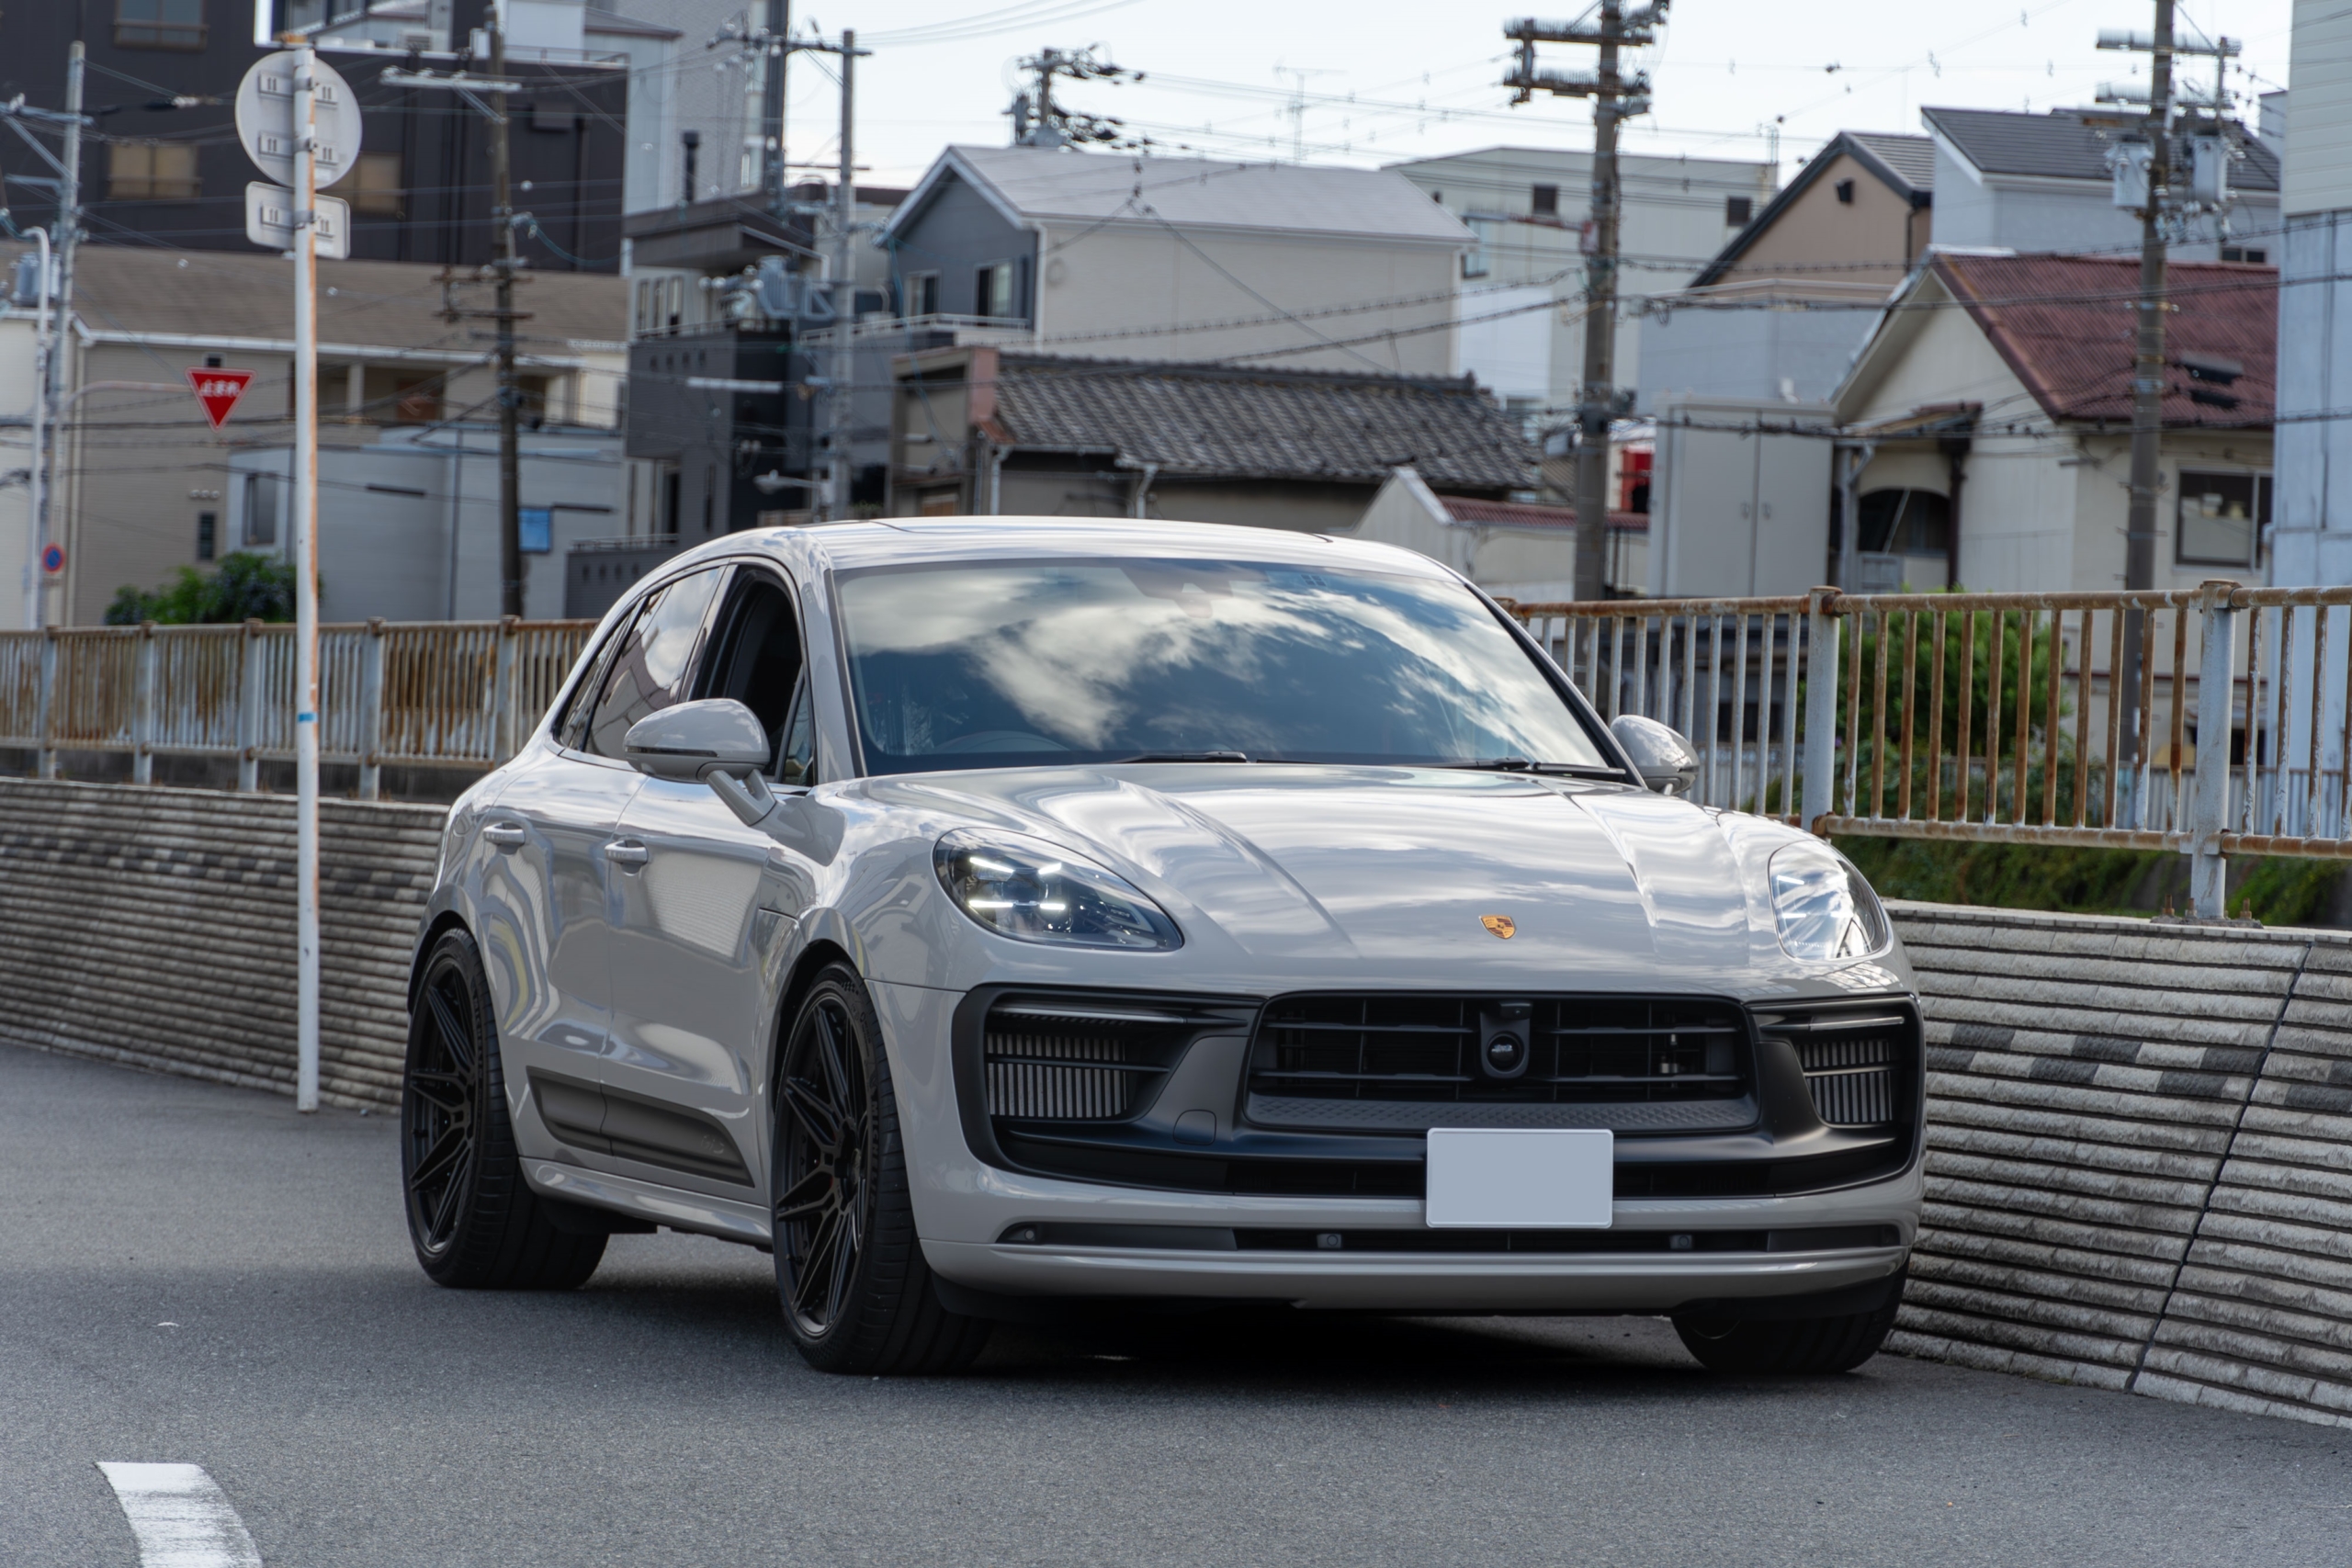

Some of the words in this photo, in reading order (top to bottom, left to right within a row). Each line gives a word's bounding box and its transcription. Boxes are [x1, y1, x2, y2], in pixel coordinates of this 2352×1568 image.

[200, 378, 241, 398] 止まれ
[868, 1100, 879, 1209] MICHELIN
